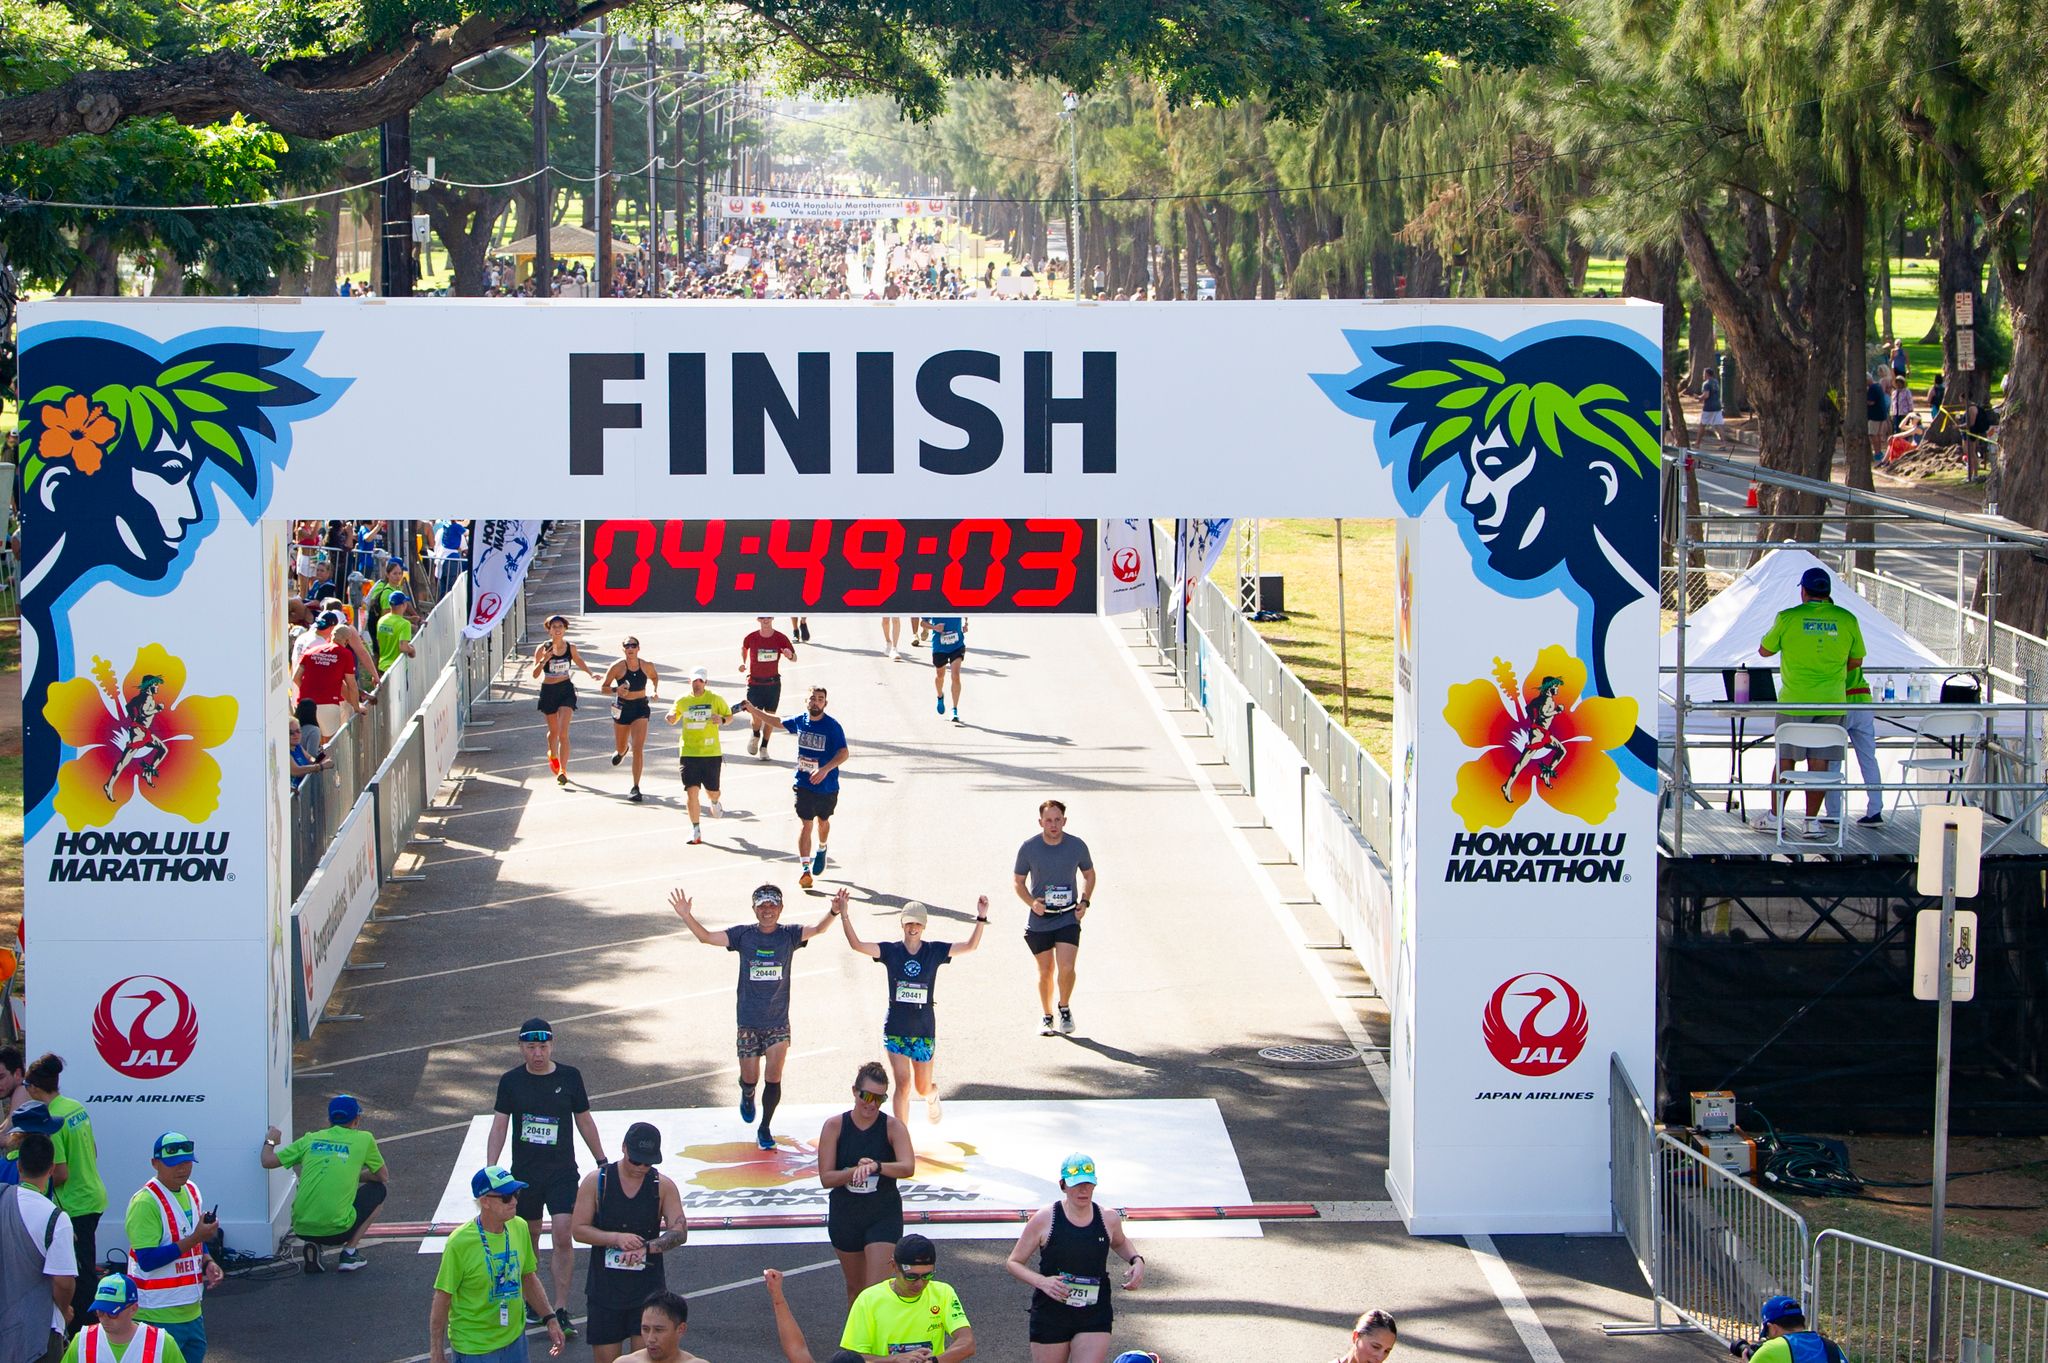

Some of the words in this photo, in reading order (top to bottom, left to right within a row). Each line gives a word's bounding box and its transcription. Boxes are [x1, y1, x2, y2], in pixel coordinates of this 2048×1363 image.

[770, 201, 801, 209] ALOHA
[569, 350, 1117, 475] FINISH
[586, 519, 1083, 606] 04:49:03
[54, 831, 230, 856] HONOLULU
[1451, 832, 1627, 857] HONOLULU
[49, 858, 229, 882] MARATHON
[1444, 859, 1625, 883] MARATHON
[901, 991, 922, 999] 20441
[120, 1049, 178, 1067] JAL
[1510, 1046, 1568, 1064] JAL
[86, 1094, 133, 1103] JAPAN
[135, 1094, 206, 1103] AIRLINES
[1475, 1092, 1522, 1100] JAPAN
[1525, 1092, 1595, 1100] AIRLINES
[526, 1126, 551, 1135] 20418
[682, 1193, 980, 1208] MARAON
[683, 1184, 976, 1199] HONOL
